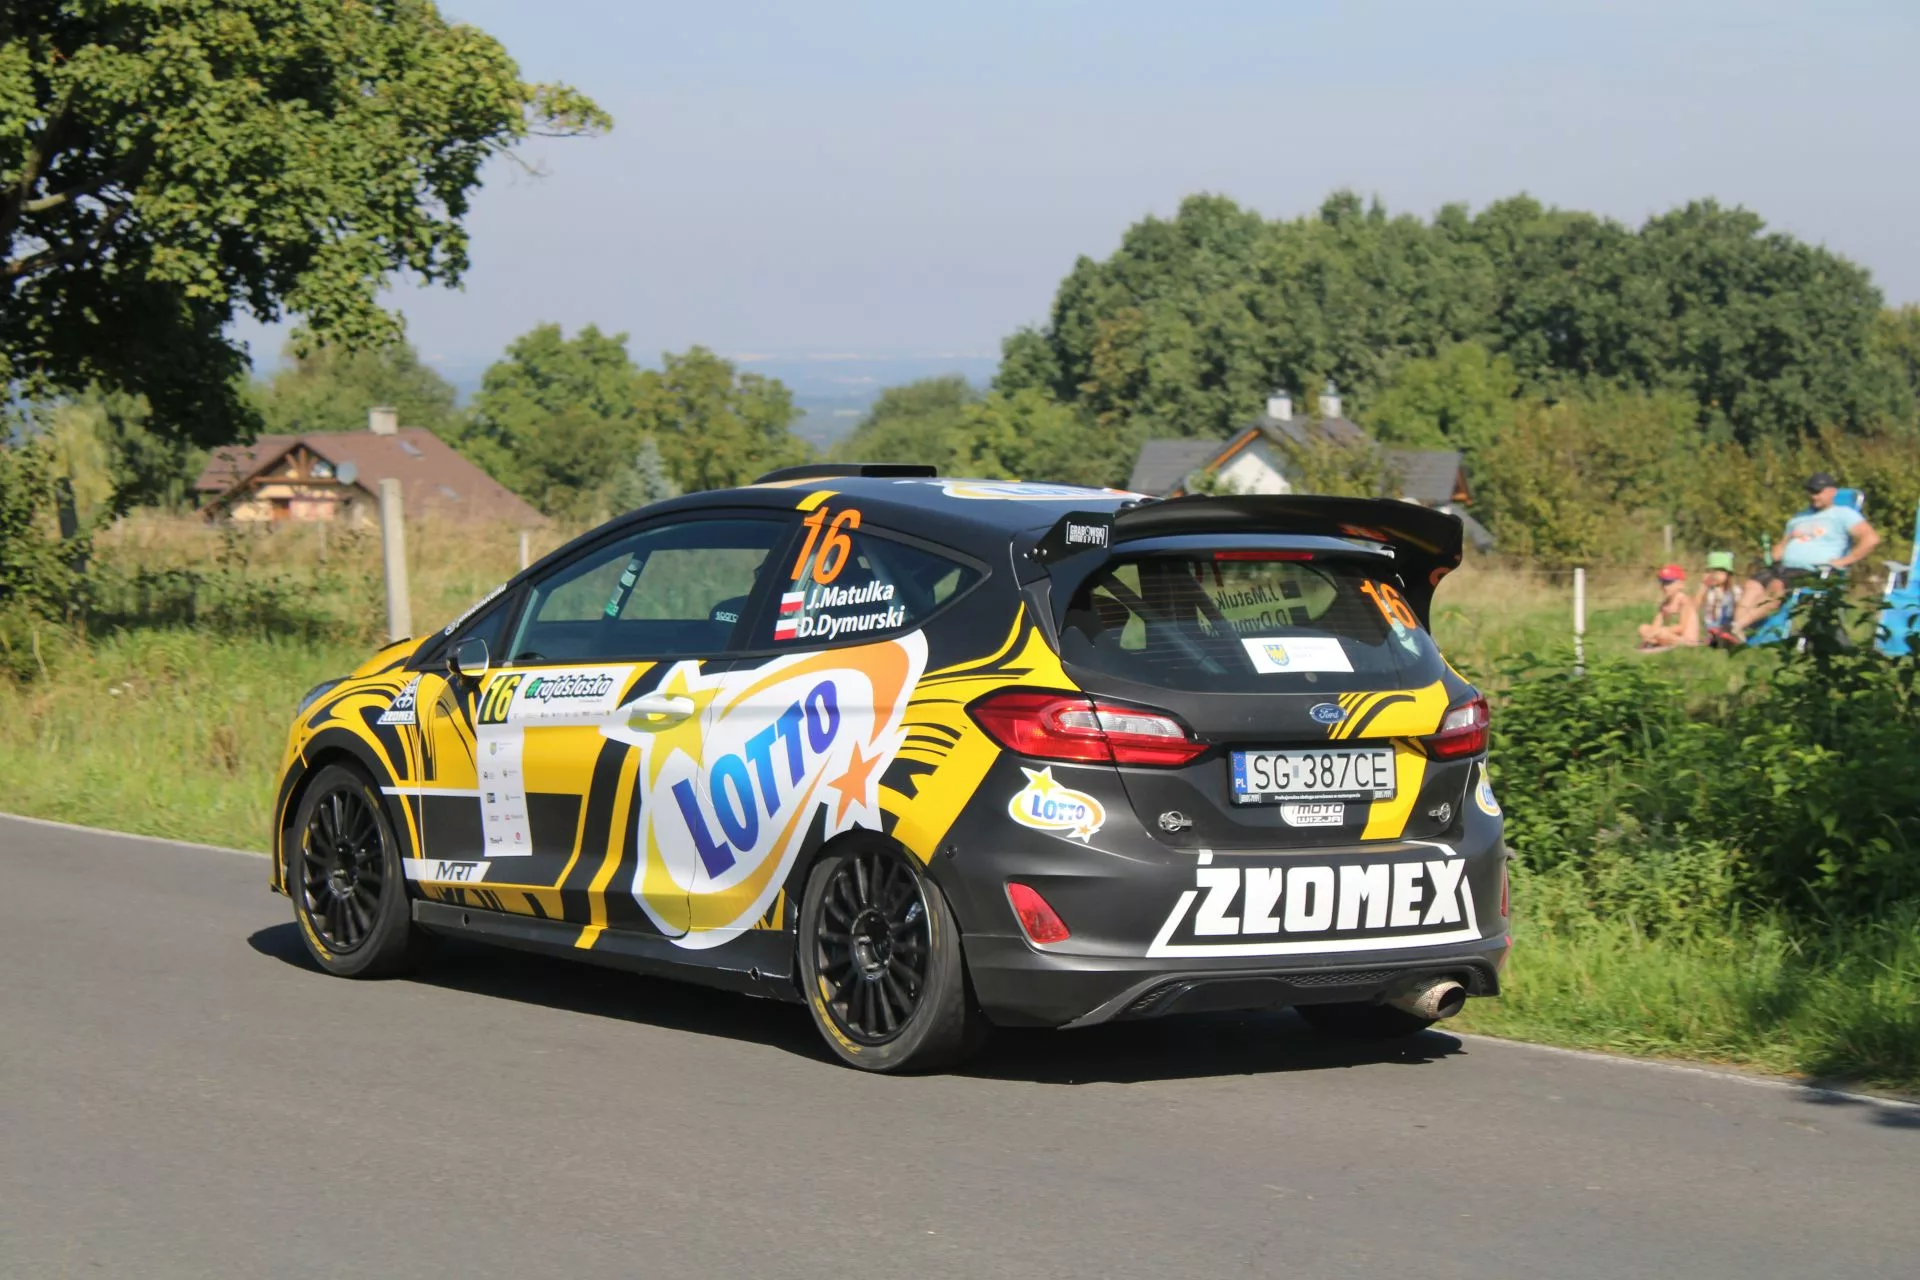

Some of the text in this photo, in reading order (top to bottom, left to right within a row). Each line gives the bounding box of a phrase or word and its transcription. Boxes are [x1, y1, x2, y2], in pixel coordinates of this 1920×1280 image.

[790, 506, 861, 585] 16
[806, 580, 895, 610] J.Matulka
[1360, 579, 1416, 630] 16
[797, 605, 906, 640] D.Dymurski
[483, 676, 521, 722] 16
[1319, 706, 1340, 720] Ford
[672, 680, 840, 880] LOTTO
[1235, 778, 1247, 788] PL
[1253, 753, 1388, 790] SG 387CE
[1031, 794, 1086, 820] LOTTO
[1297, 804, 1343, 815] MOTO
[436, 862, 478, 881] MRT
